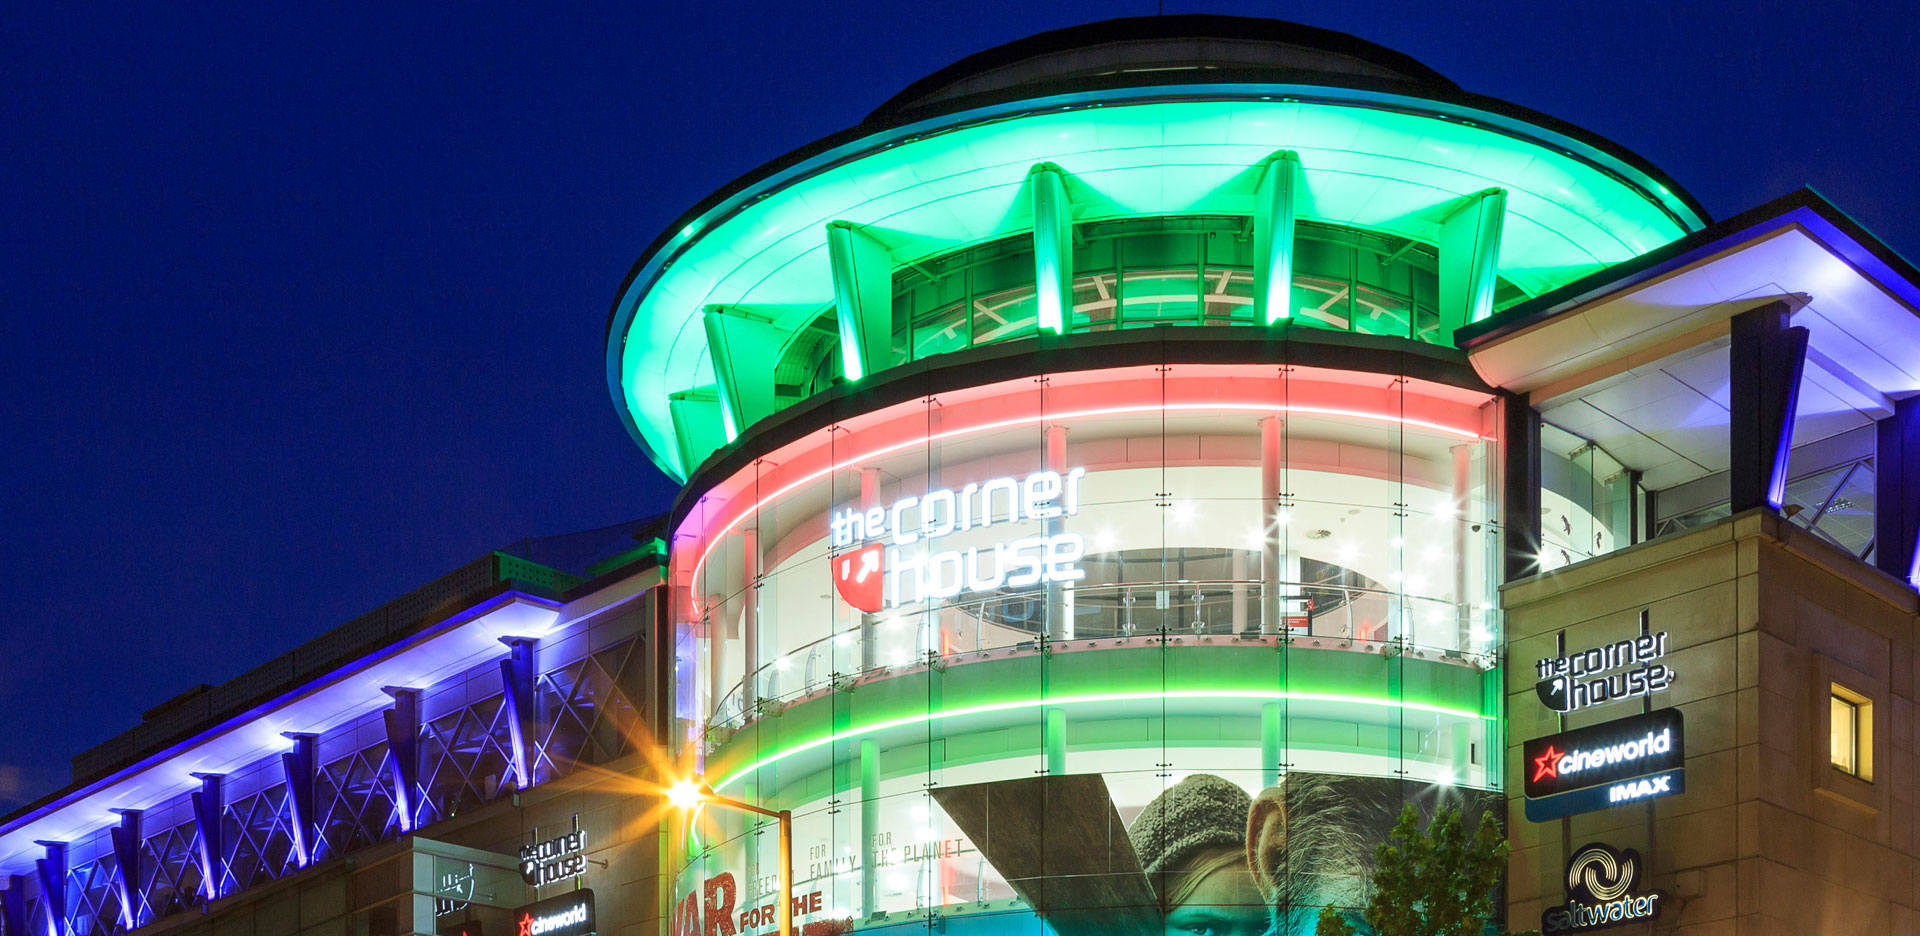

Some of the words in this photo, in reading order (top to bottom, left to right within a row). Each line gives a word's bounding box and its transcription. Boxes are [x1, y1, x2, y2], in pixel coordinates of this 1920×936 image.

[831, 507, 886, 546] the
[891, 467, 1085, 546] corner
[890, 533, 1085, 608] house
[1536, 657, 1570, 680] the
[1569, 631, 1668, 679] corner
[1569, 664, 1668, 711] house
[1558, 728, 1670, 775] cineworld
[1609, 776, 1671, 802] IMAX
[810, 844, 827, 860] FOR
[872, 832, 892, 848] FOR
[904, 839, 963, 863] PLANET
[531, 903, 587, 936] cineworld
[740, 904, 775, 933] FOR
[785, 891, 823, 918] HE
[1546, 894, 1659, 932] saltwater
